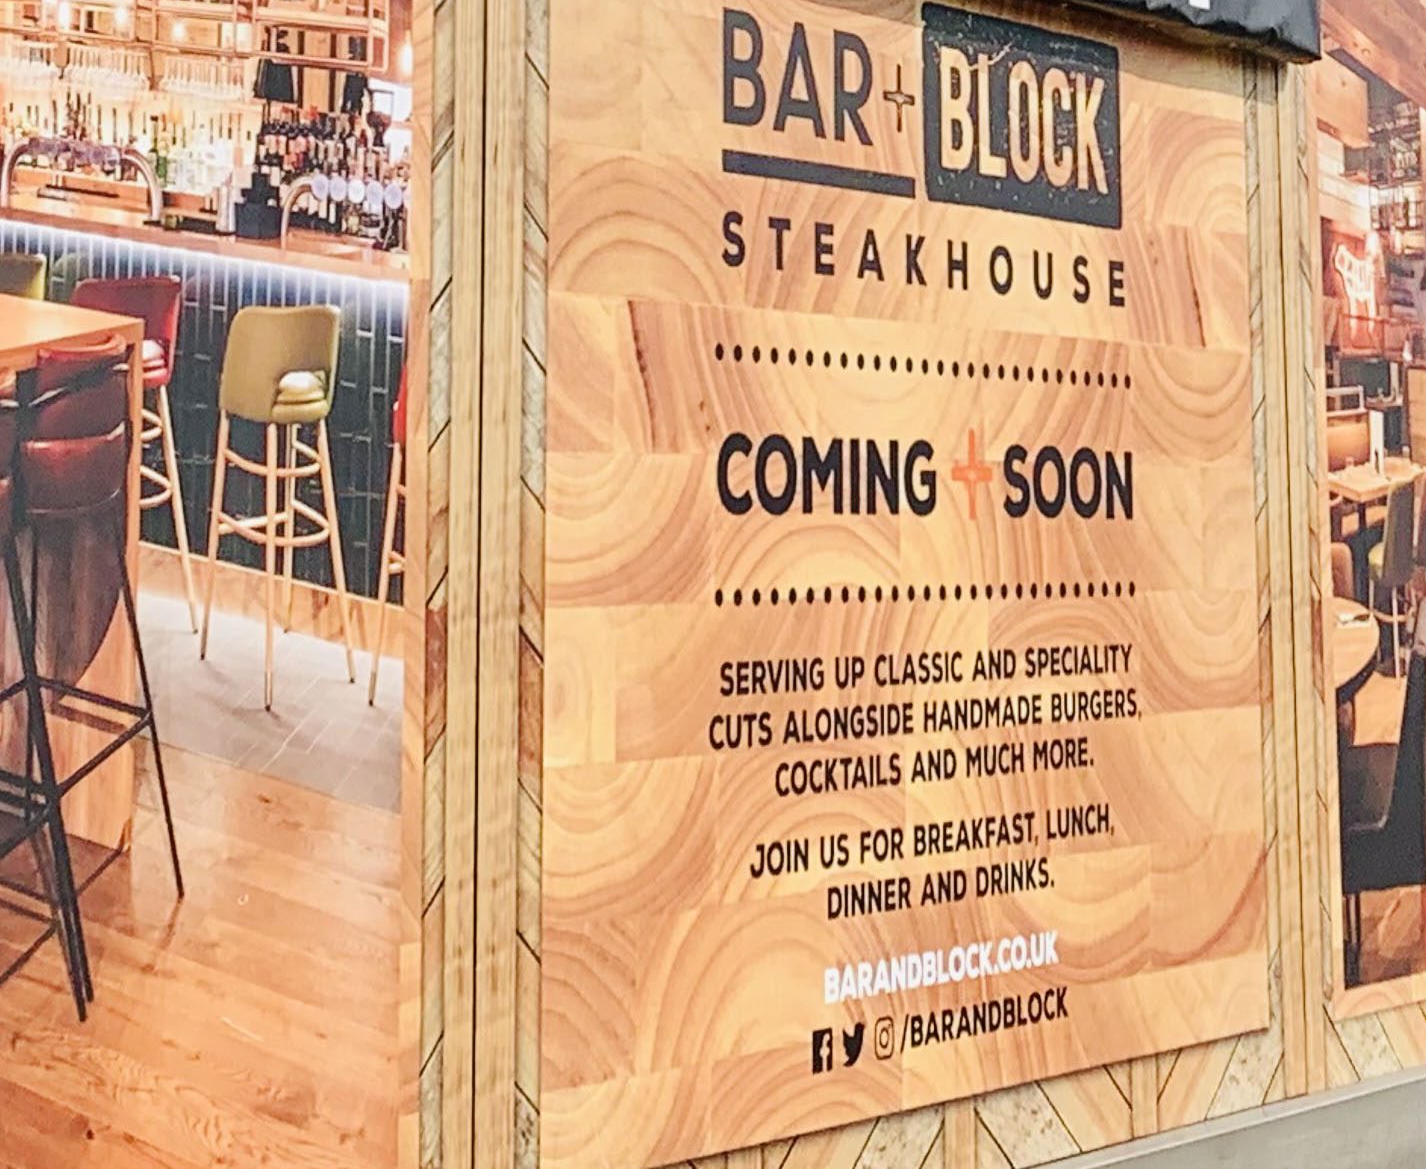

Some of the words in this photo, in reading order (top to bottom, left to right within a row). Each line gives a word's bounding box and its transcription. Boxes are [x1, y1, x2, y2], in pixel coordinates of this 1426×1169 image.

[938, 45, 1110, 196] BLOCK
[722, 211, 1126, 308] STEAKHOUSE
[717, 432, 937, 517] COMING
[1003, 444, 1133, 520] SOON
[720, 658, 825, 696] SERVING
[835, 656, 864, 689] UP
[874, 651, 963, 687] CLASSIC
[972, 649, 1016, 682] AND
[1024, 644, 1133, 679] SPECIALITY
[709, 712, 773, 750] CUTS
[782, 703, 915, 745] ALONGSIDE
[923, 694, 1043, 733] HANDMADE
[1050, 688, 1142, 723] BURGERS,
[775, 753, 901, 796] COCKTAILS
[911, 748, 957, 784] AND
[966, 743, 1024, 778] MUCH
[1033, 737, 1095, 771] MORE.
[750, 839, 809, 879] JOIN
[819, 833, 850, 870] US
[860, 828, 904, 864] FOR
[913, 812, 1039, 857] BREAKFAST,
[1045, 803, 1115, 840] LUNCH,
[827, 877, 912, 920] DINNER
[920, 871, 967, 906] AND
[976, 858, 1055, 898] DRINKS.
[823, 931, 1060, 1005] BARANDBLOCK.CO.UK
